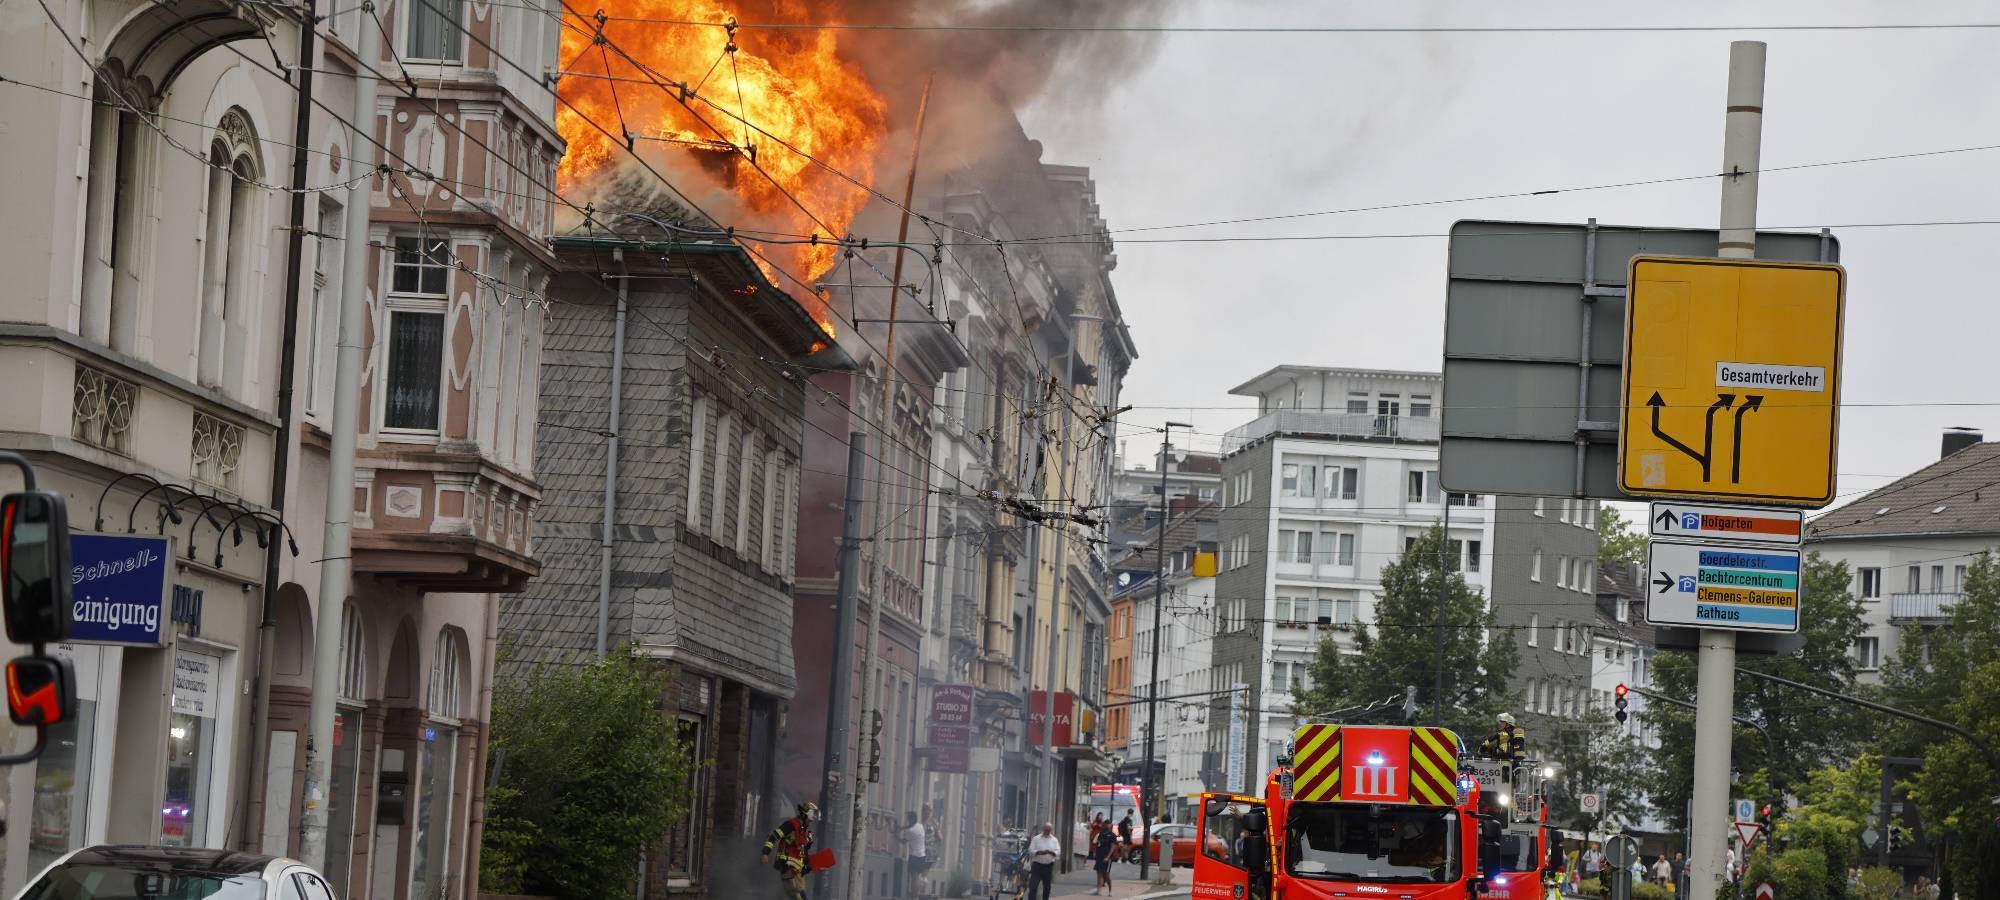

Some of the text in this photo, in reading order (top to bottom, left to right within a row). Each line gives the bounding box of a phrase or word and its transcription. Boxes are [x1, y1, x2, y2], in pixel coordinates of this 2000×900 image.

[1721, 367, 1819, 387] Gesamtverkehr
[1701, 514, 1753, 531] Hofgarten
[72, 548, 159, 585] Schnell-
[1699, 552, 1768, 569] Goerdelerstr.
[1698, 569, 1783, 588] Bachtorcentrum
[1697, 587, 1792, 606] Clemens-Galerien
[72, 595, 159, 633] einigung
[1696, 605, 1740, 620] Rathaus
[1030, 712, 1070, 726] KYTA
[1352, 765, 1399, 797] III
[1194, 886, 1231, 897] FEUERWEHR
[1357, 885, 1389, 894] MAGIRUS
